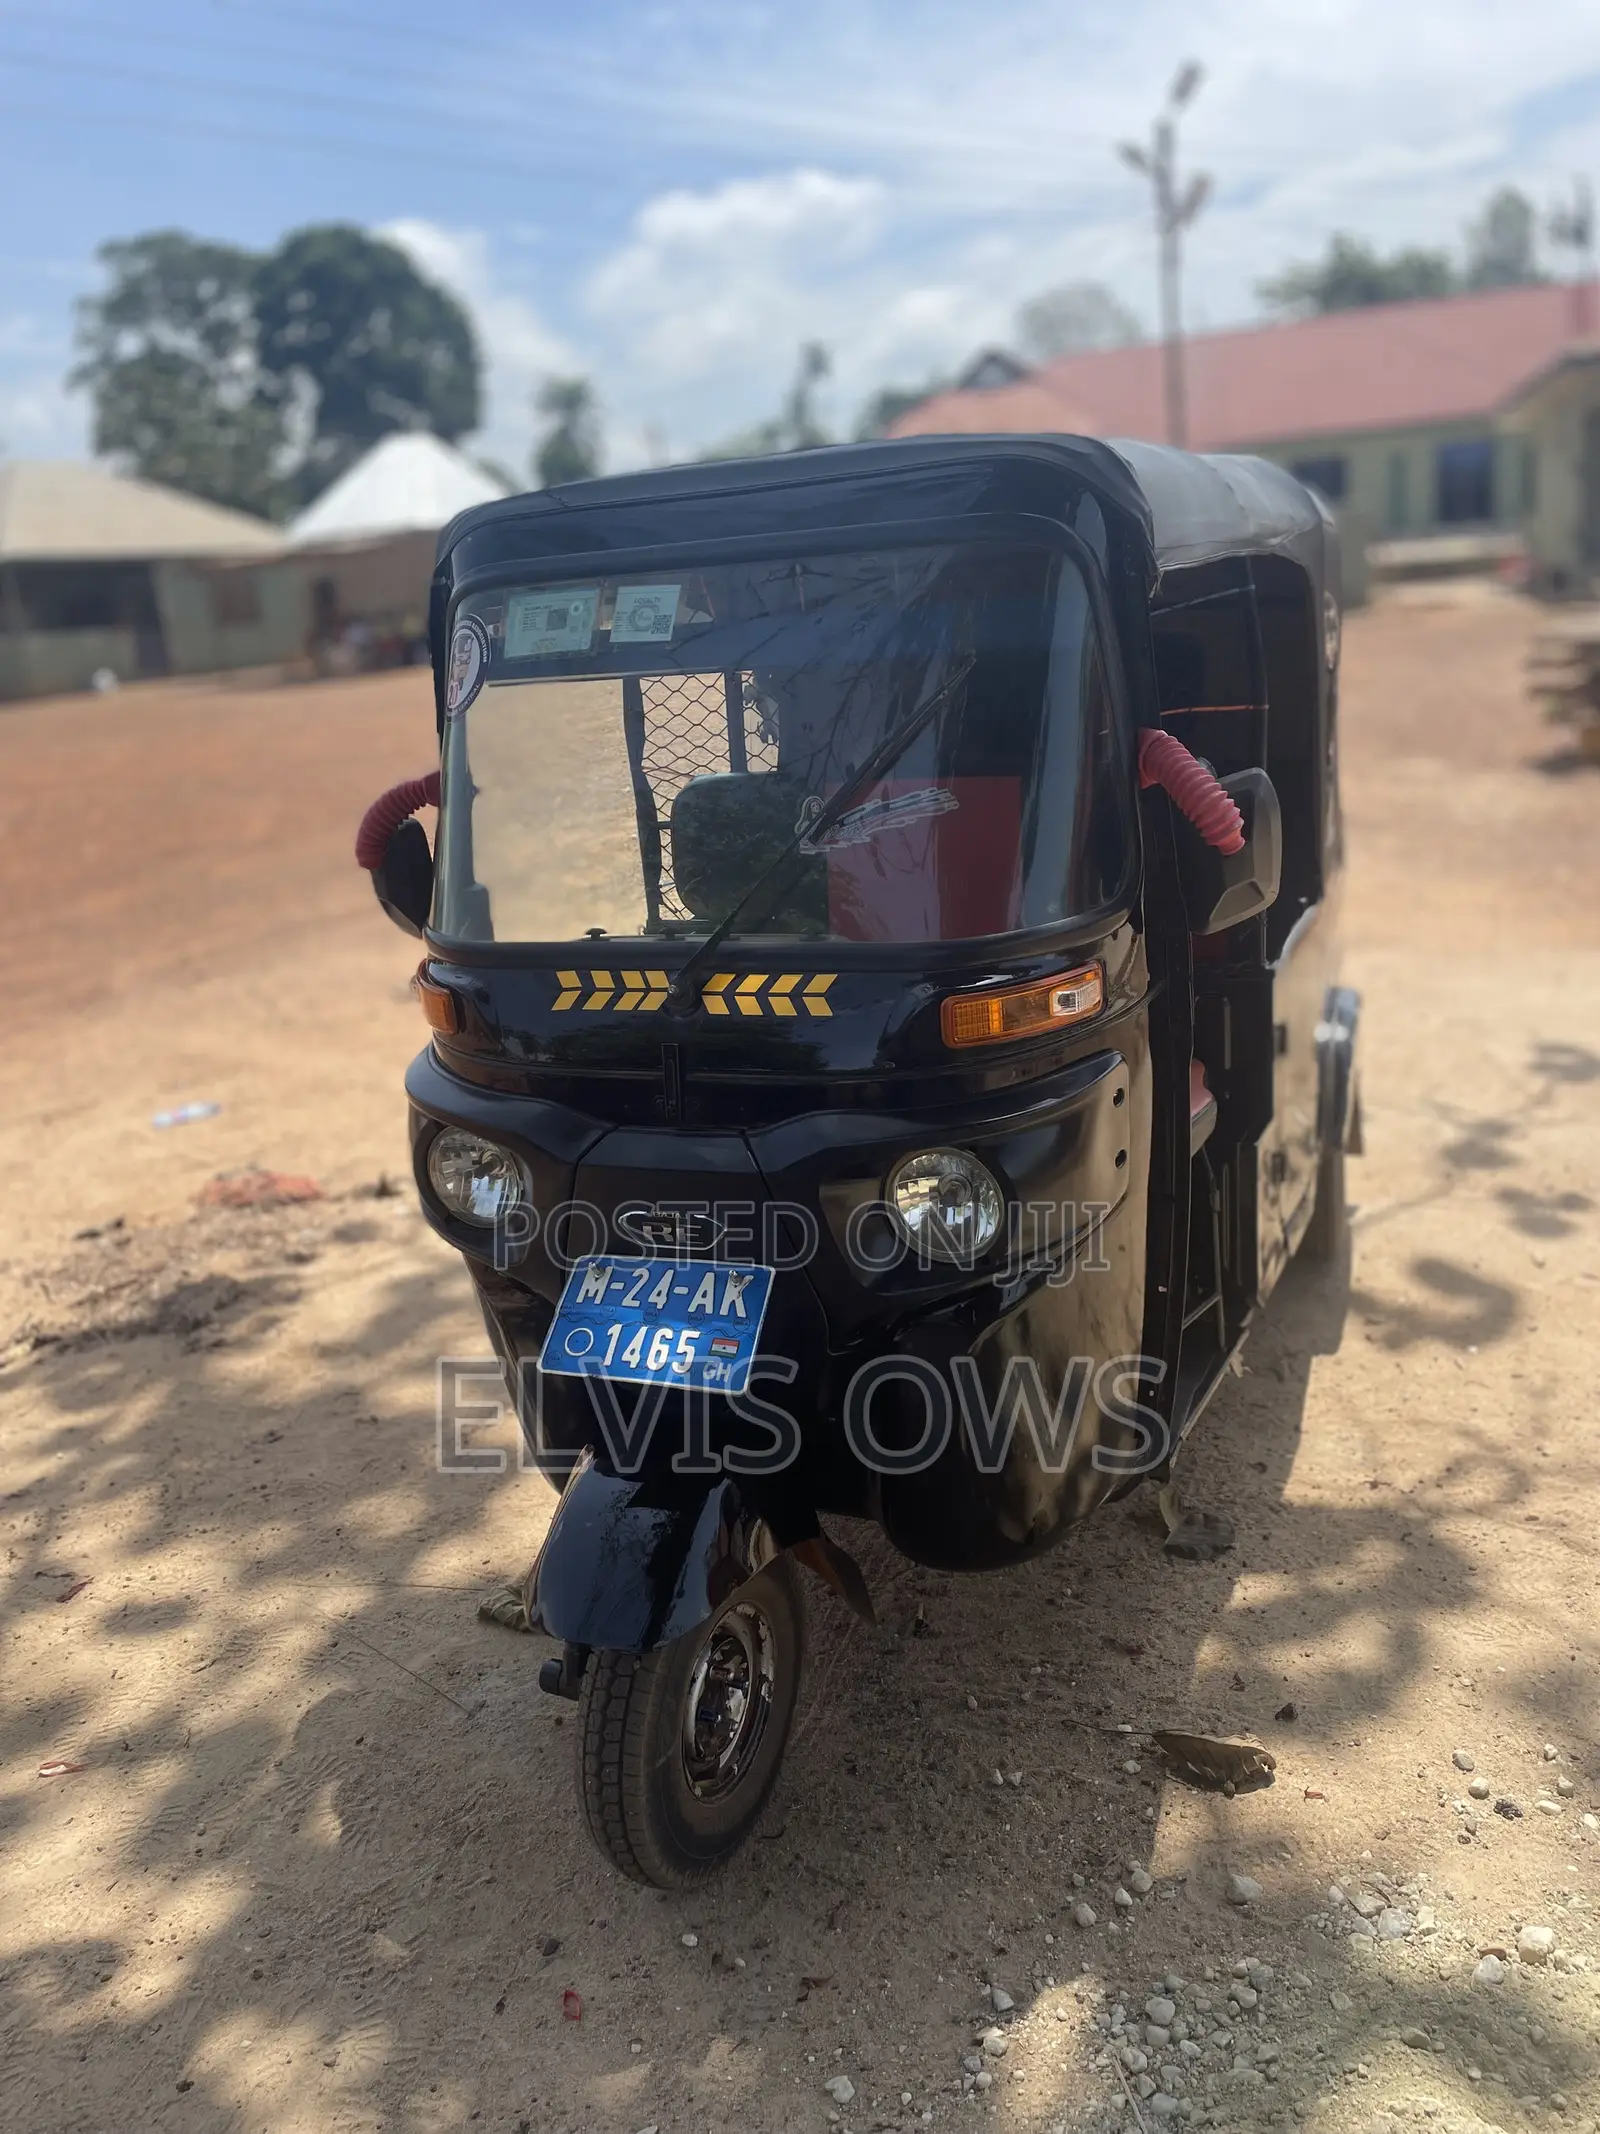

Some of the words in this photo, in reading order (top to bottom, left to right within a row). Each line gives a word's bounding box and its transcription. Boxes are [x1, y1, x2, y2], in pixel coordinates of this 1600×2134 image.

[459, 683, 481, 712] CENTRAL
[642, 1222, 704, 1245] RE
[576, 1265, 755, 1318] M-24-AK
[602, 1324, 701, 1375] 1465
[702, 1361, 732, 1383] GH
